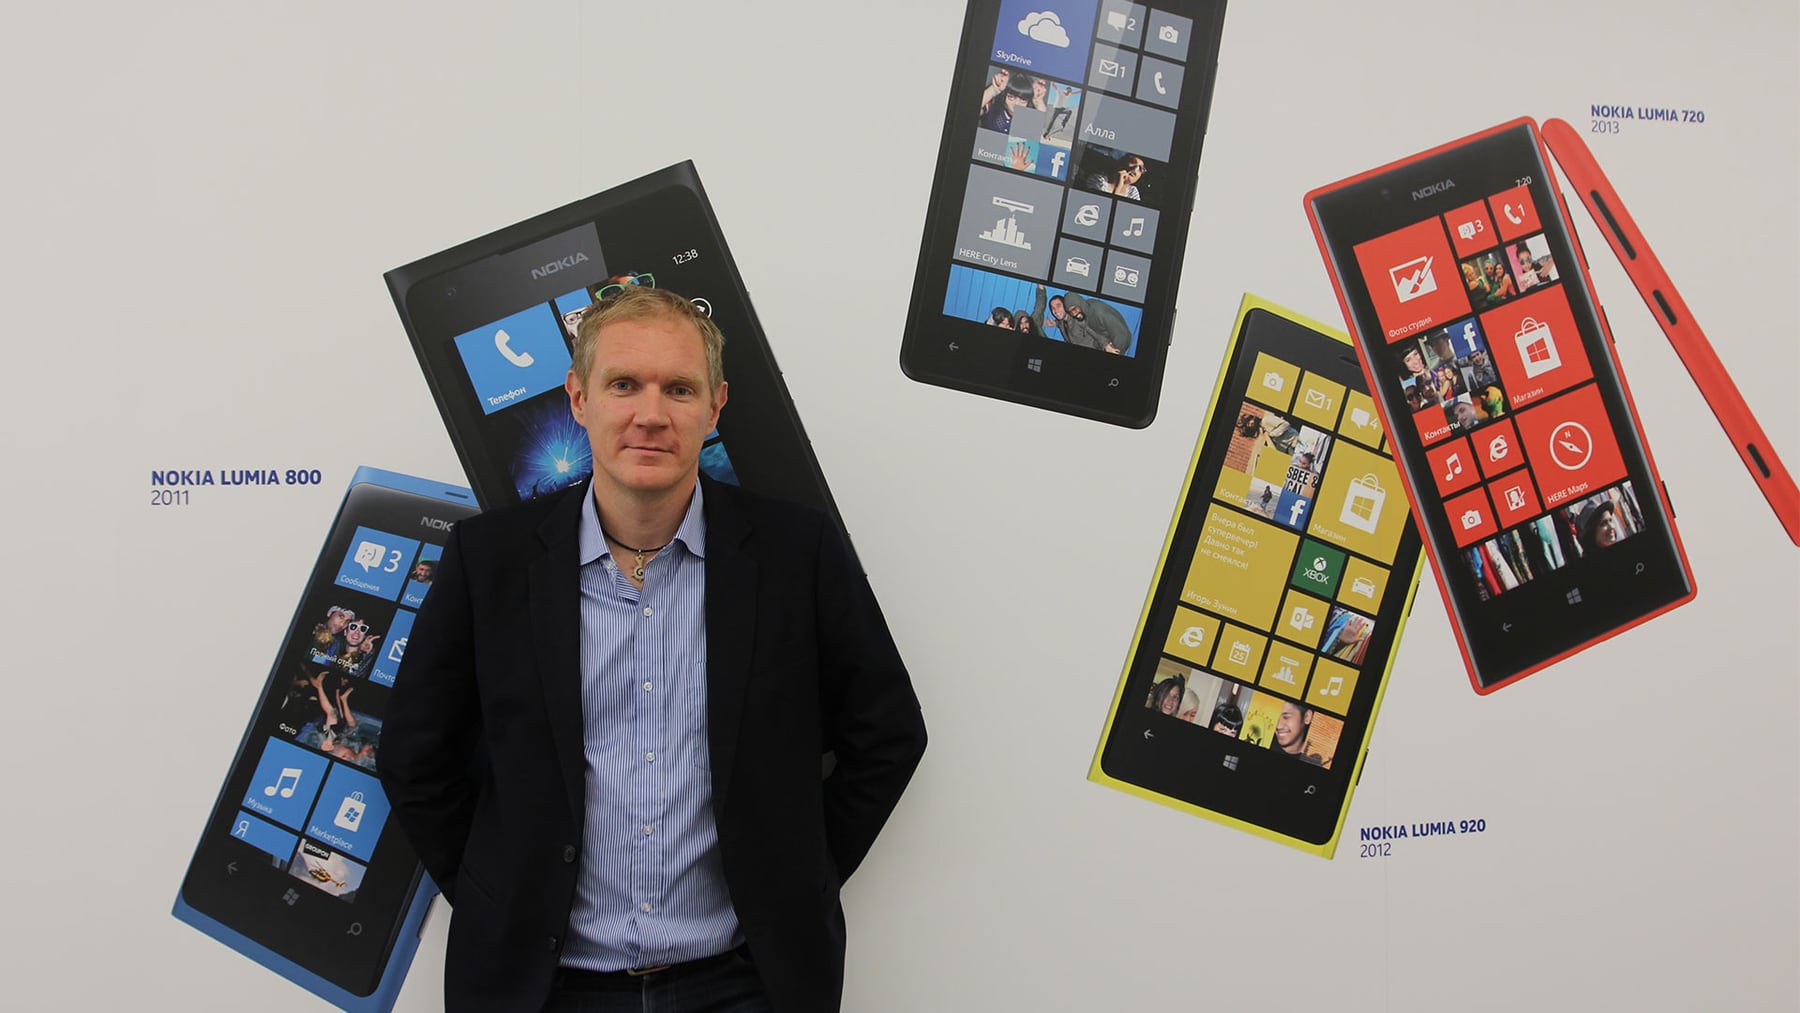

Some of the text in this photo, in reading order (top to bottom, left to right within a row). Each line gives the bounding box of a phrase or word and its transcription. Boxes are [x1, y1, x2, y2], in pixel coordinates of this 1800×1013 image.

[1127, 18, 1136, 31] 2
[996, 50, 1032, 67] SkyDrive
[1119, 66, 1126, 78] 1
[1591, 105, 1705, 123] NOKIA LUMIA 720
[1085, 123, 1116, 140] Алла
[1591, 120, 1620, 134] 2013
[1411, 179, 1455, 200] NOKIA
[1517, 203, 1526, 217] 1
[1474, 219, 1485, 233] 3
[672, 248, 698, 265] 12:38
[959, 248, 1018, 270] HERE City Lens
[531, 252, 589, 279] NOKIA
[1388, 316, 1433, 339] Фото студия
[487, 386, 527, 406] Телефон
[1325, 397, 1333, 411] 1
[1512, 387, 1544, 405] Магазин
[1424, 421, 1460, 441] Контакты
[151, 469, 323, 486] NOKIA LUMIA 800
[150, 489, 191, 506] 2011
[1547, 482, 1589, 504] HERE Maps
[420, 516, 454, 532] NOK
[1212, 512, 1255, 536] Вчера был
[1313, 523, 1347, 542] Магазин
[1203, 534, 1230, 551] Давно
[383, 550, 402, 573] 3
[340, 575, 380, 592] Сообщения
[1303, 567, 1330, 585] XBOX
[405, 594, 423, 604] Конт
[1234, 651, 1245, 660] 25
[279, 723, 297, 735] Фото
[248, 797, 272, 814] Музыка
[311, 825, 353, 851] Marketplace
[1360, 819, 1486, 841] NOKIA LUMIA 920
[1360, 842, 1392, 858] 2012
